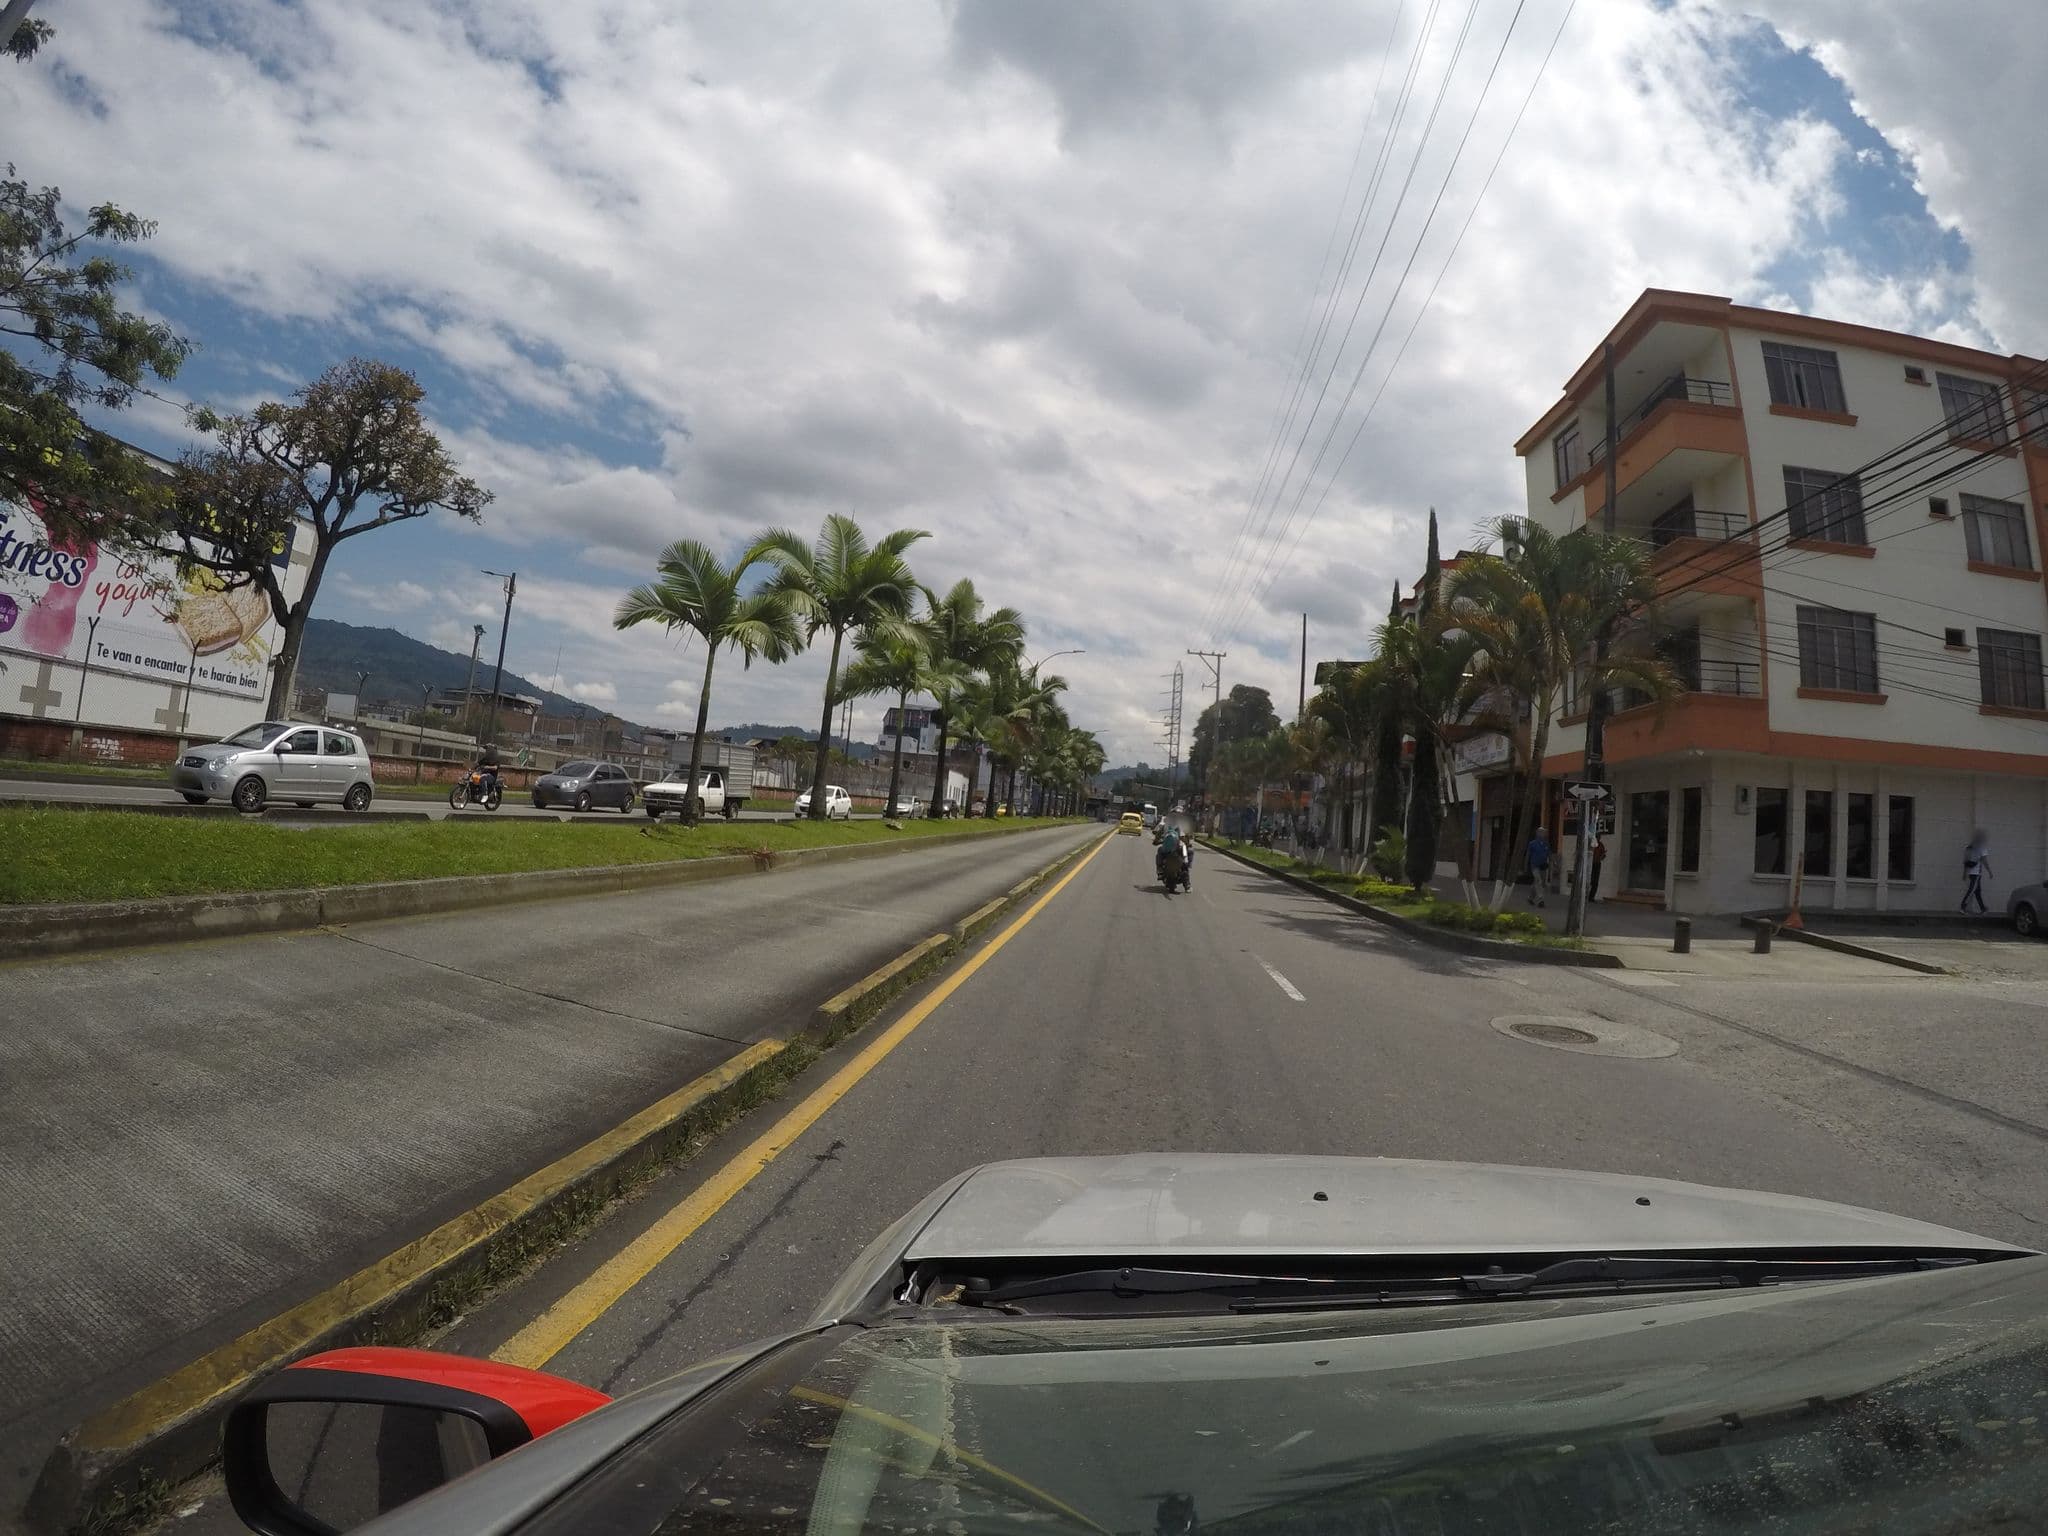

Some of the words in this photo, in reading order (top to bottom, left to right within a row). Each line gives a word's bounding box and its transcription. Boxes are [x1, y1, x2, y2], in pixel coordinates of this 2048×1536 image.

[0, 515, 86, 586] tness
[97, 642, 109, 658] Te
[112, 650, 131, 663] van
[134, 655, 142, 665] a
[144, 657, 187, 674] encantar
[198, 666, 209, 678] te
[210, 666, 237, 684] harán
[239, 673, 258, 688] bien
